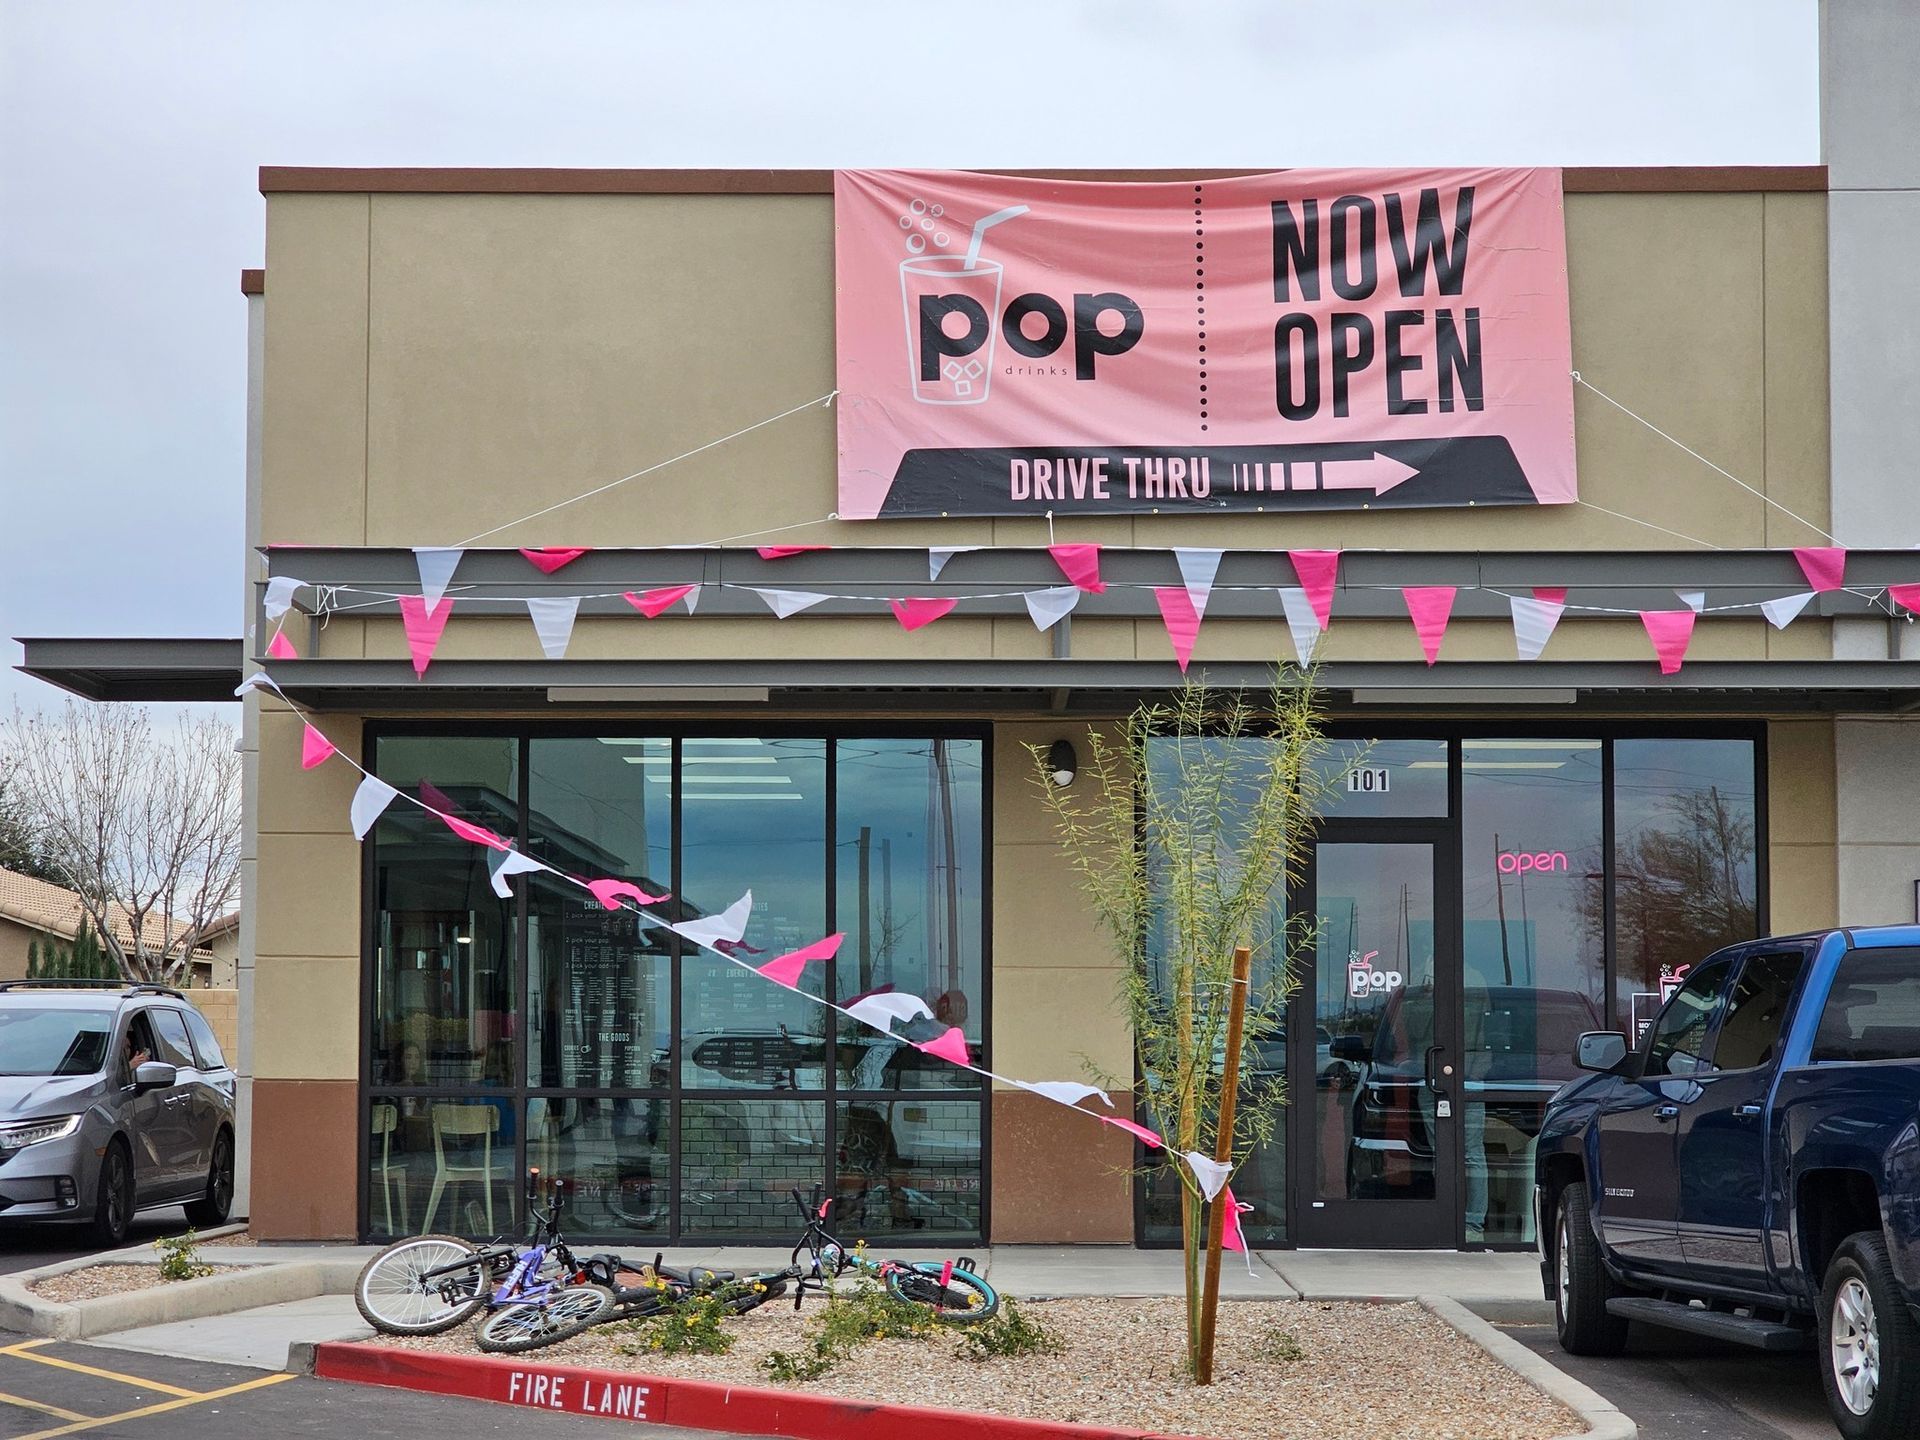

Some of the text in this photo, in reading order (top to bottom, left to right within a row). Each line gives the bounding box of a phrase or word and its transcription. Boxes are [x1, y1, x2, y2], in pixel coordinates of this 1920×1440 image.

[1272, 186, 1476, 303] NOW
[919, 292, 1144, 382] pop
[1005, 365, 1069, 377] drinks
[1274, 308, 1484, 421] OPEN
[1010, 455, 1210, 502] DRIVE THRU
[1351, 769, 1388, 791] 101
[1497, 850, 1568, 876] open
[1353, 971, 1402, 992] pop
[510, 1372, 650, 1419] FIRE LANE
